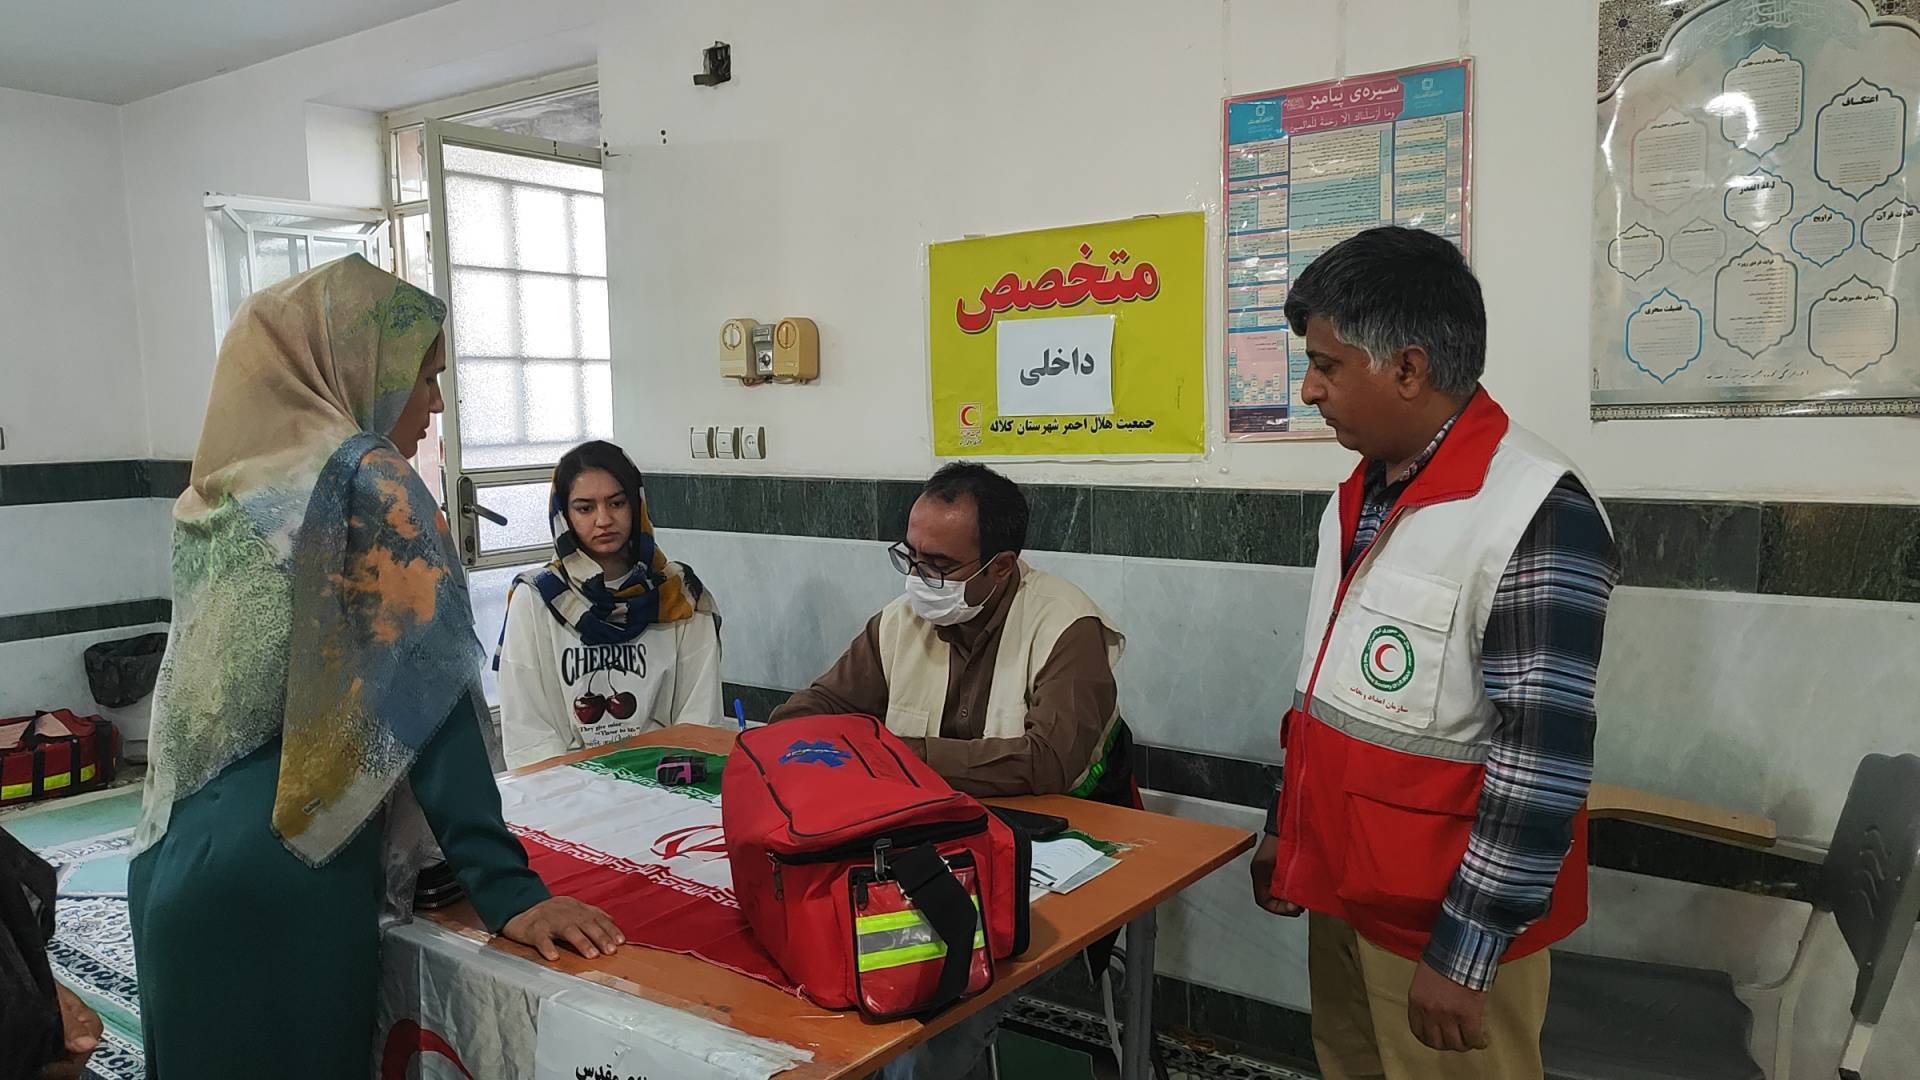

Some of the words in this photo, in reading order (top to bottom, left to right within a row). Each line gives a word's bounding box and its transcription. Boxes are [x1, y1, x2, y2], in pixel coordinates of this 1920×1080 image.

[955, 242, 1160, 334] متخصص
[1020, 347, 1095, 386] داخلی
[990, 420, 1014, 433] کلاله
[1017, 418, 1059, 435] شهرستان
[1063, 418, 1088, 435] احمر
[1090, 416, 1113, 433] هلال
[1117, 418, 1155, 433] جمعیت
[561, 644, 646, 686] CHERRIES
